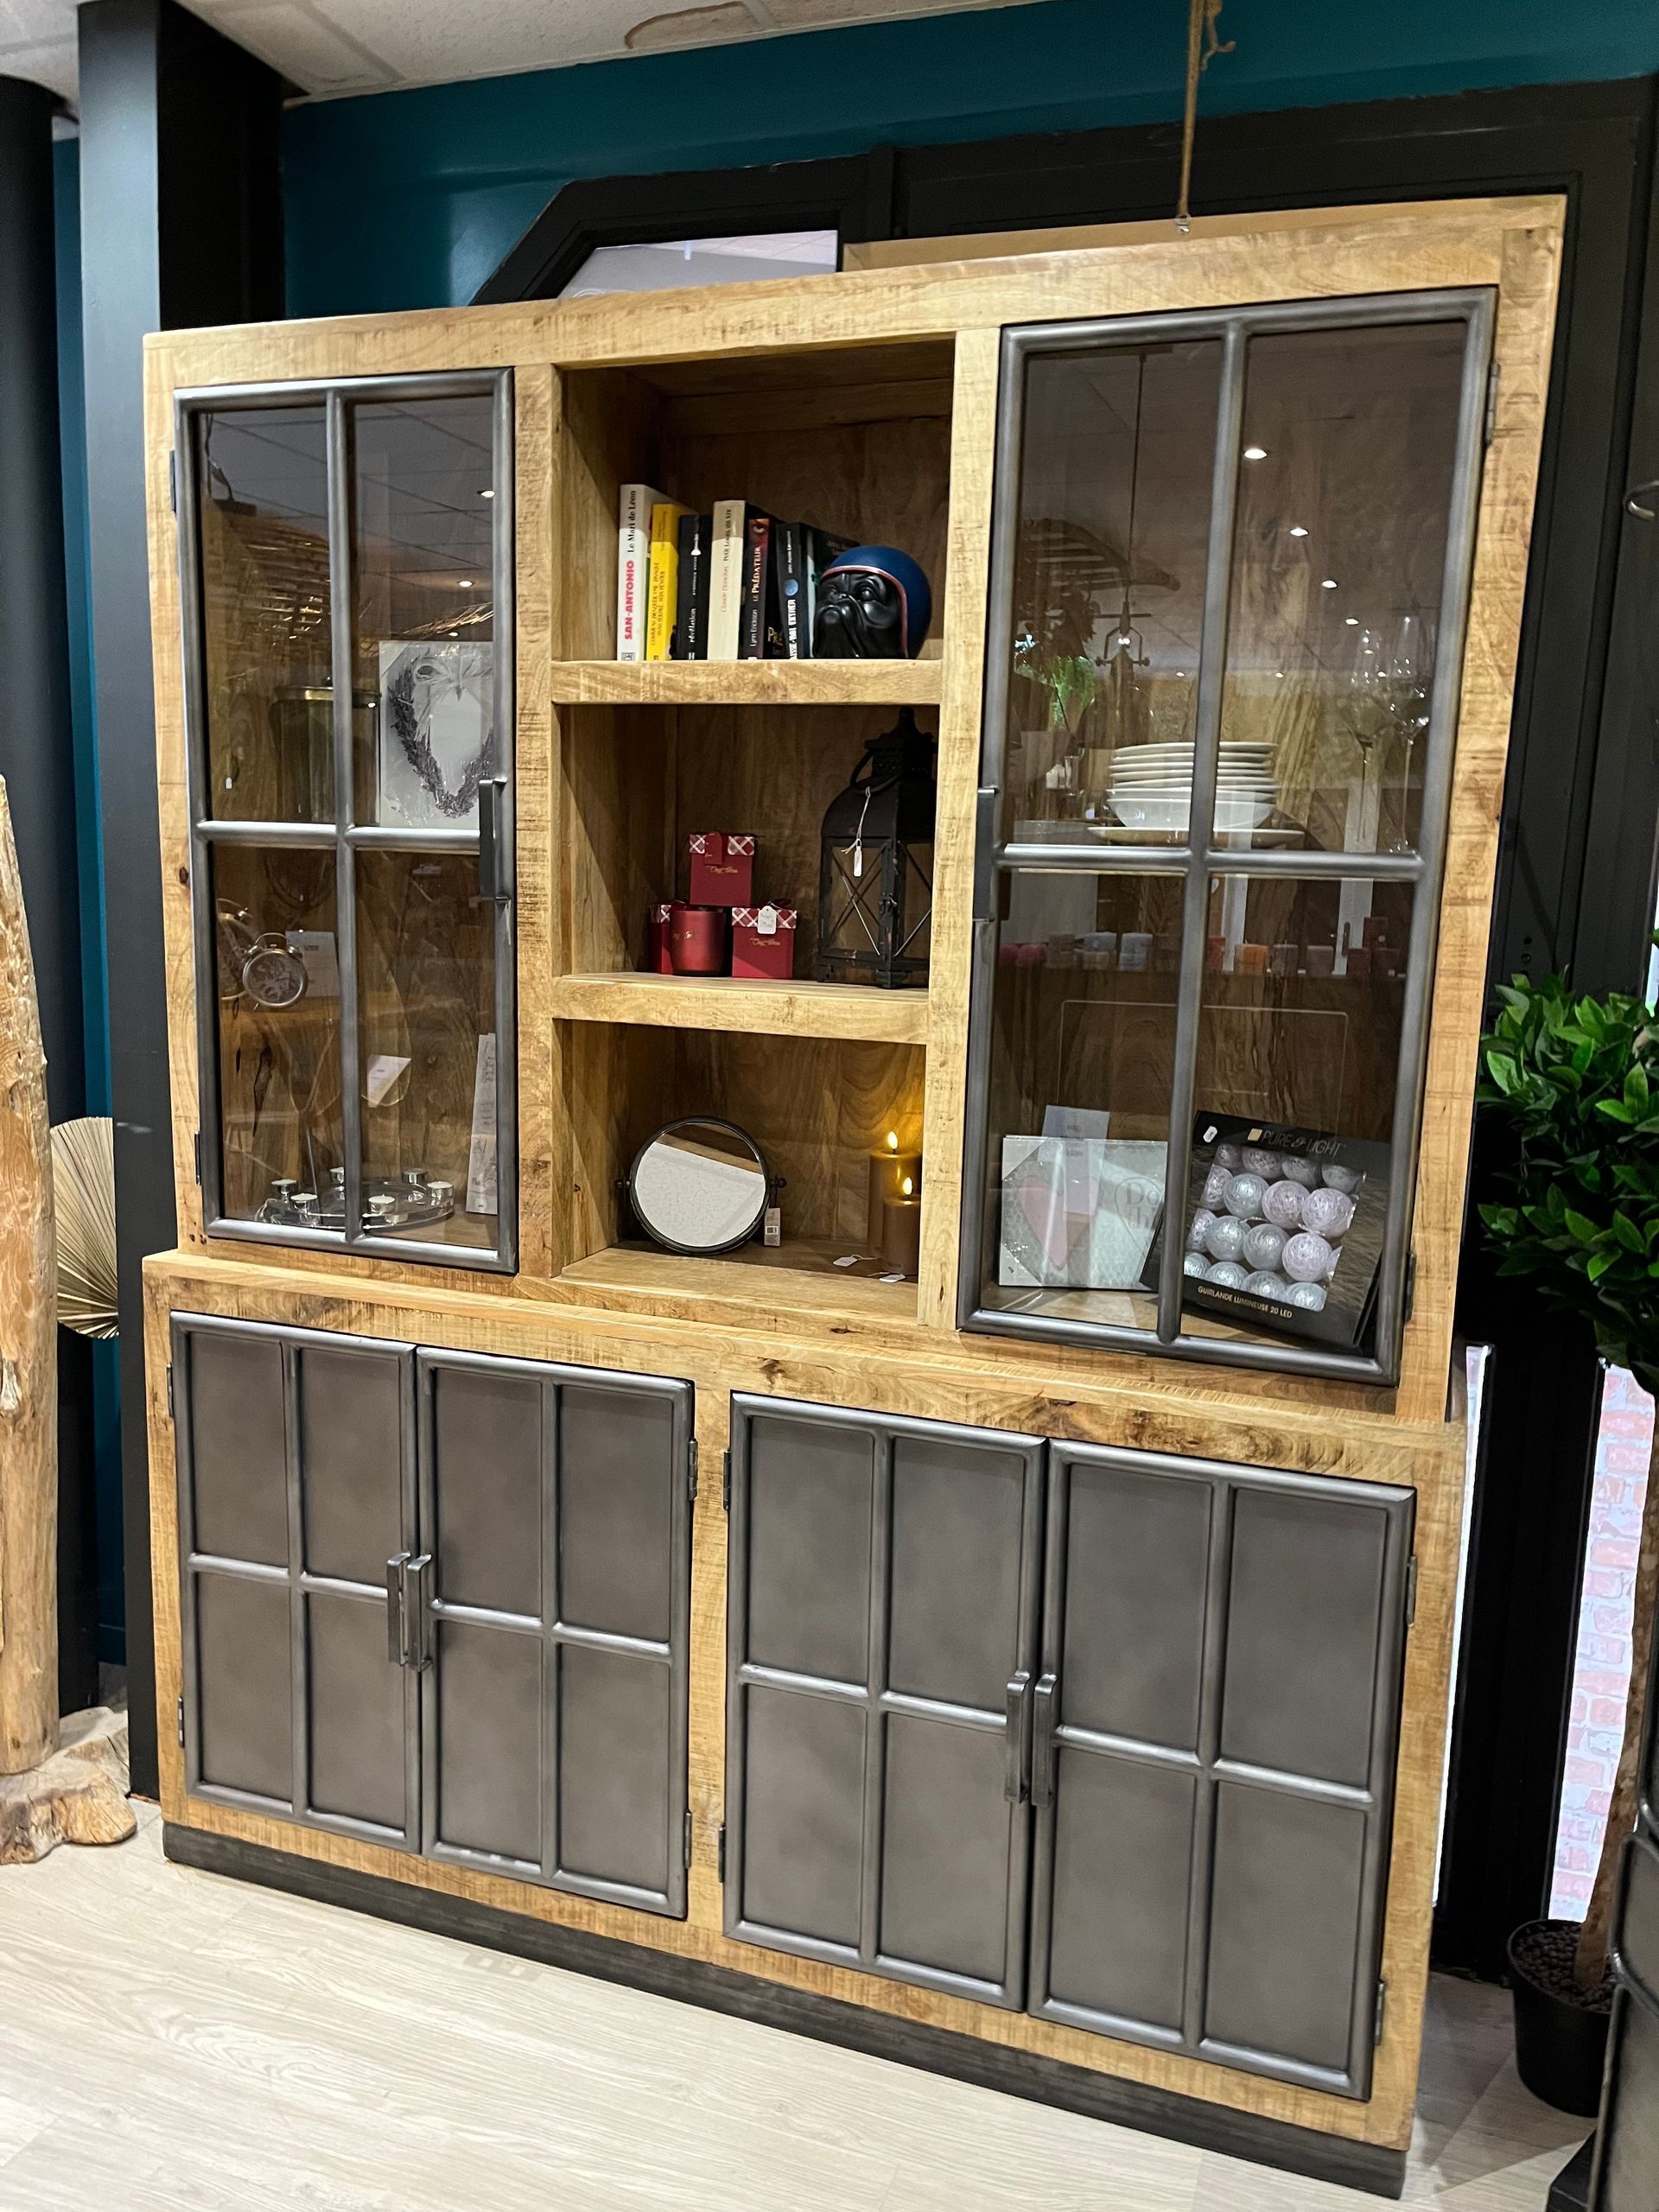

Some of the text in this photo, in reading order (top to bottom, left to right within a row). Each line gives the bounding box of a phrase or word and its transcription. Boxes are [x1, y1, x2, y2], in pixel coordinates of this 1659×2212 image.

[626, 490, 637, 553] Le Mari de Léon
[752, 545, 761, 594] PRÉDATEUR
[624, 560, 635, 640] SAN-ANTONIO
[688, 607, 696, 643] révélation
[1261, 1128, 1294, 1149] PURE
[1306, 1139, 1342, 1157] LIGHT
[1198, 1285, 1293, 1319] GUIRLANDE LUMINEUSE 20 LED
